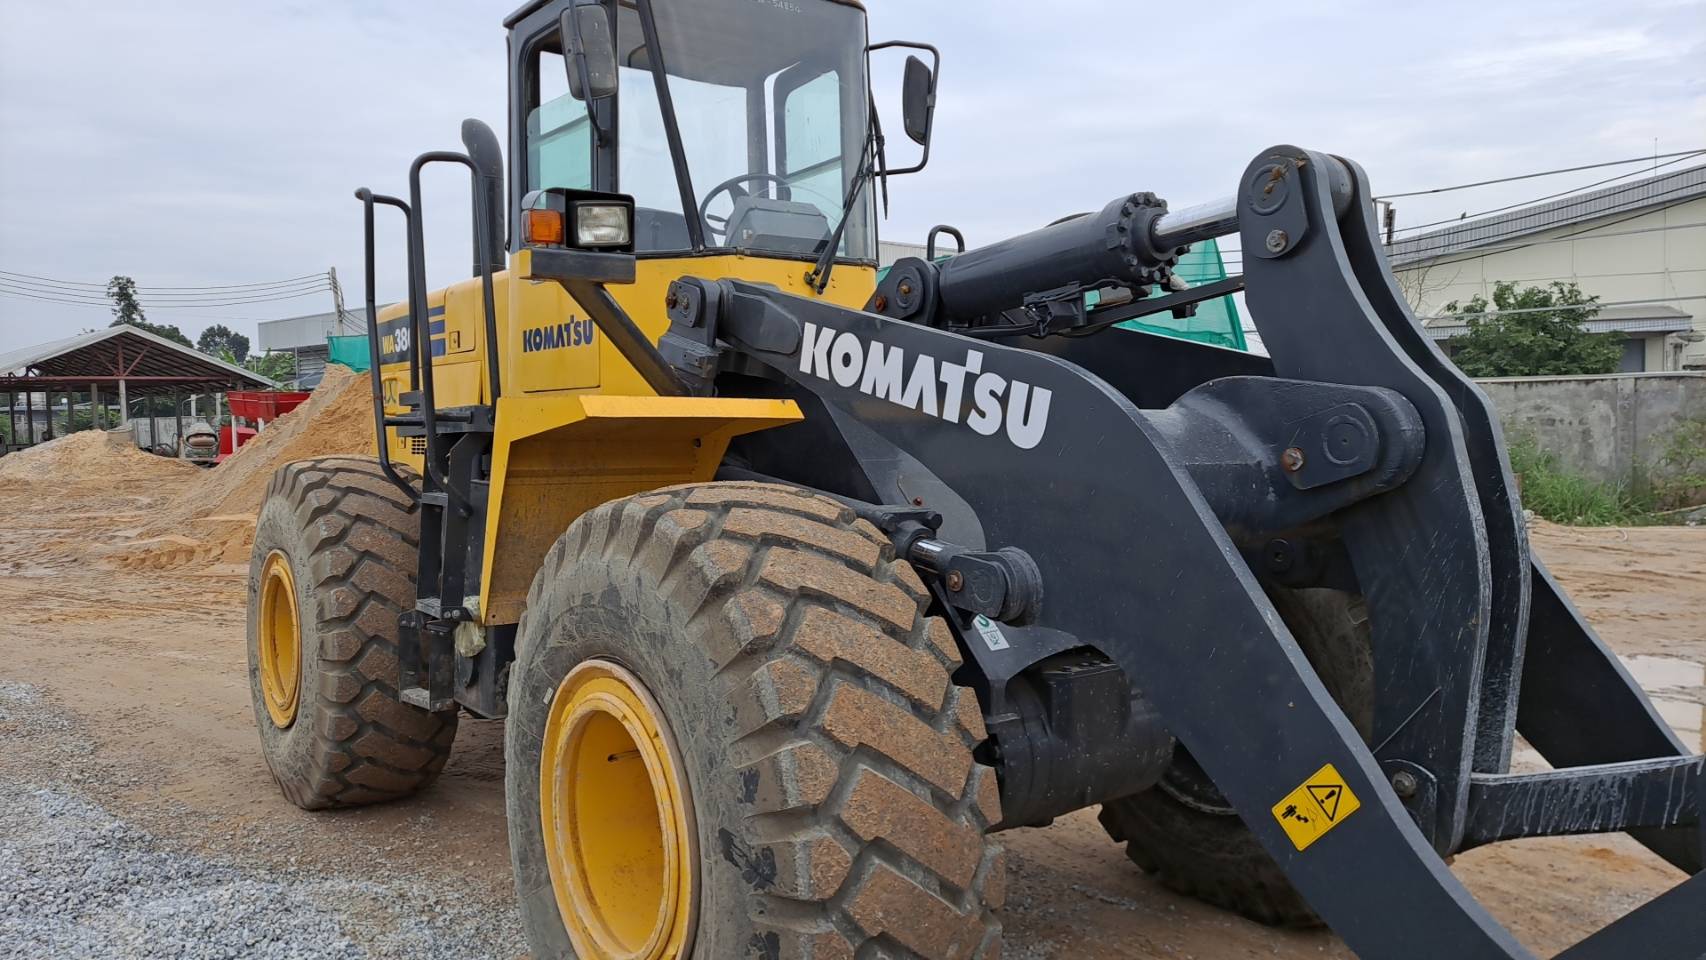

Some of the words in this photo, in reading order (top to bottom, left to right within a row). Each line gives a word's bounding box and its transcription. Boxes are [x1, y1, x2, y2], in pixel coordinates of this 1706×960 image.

[382, 327, 410, 355] WA38
[523, 315, 593, 352] KOMATSU
[799, 322, 1053, 449] KOMATSU
